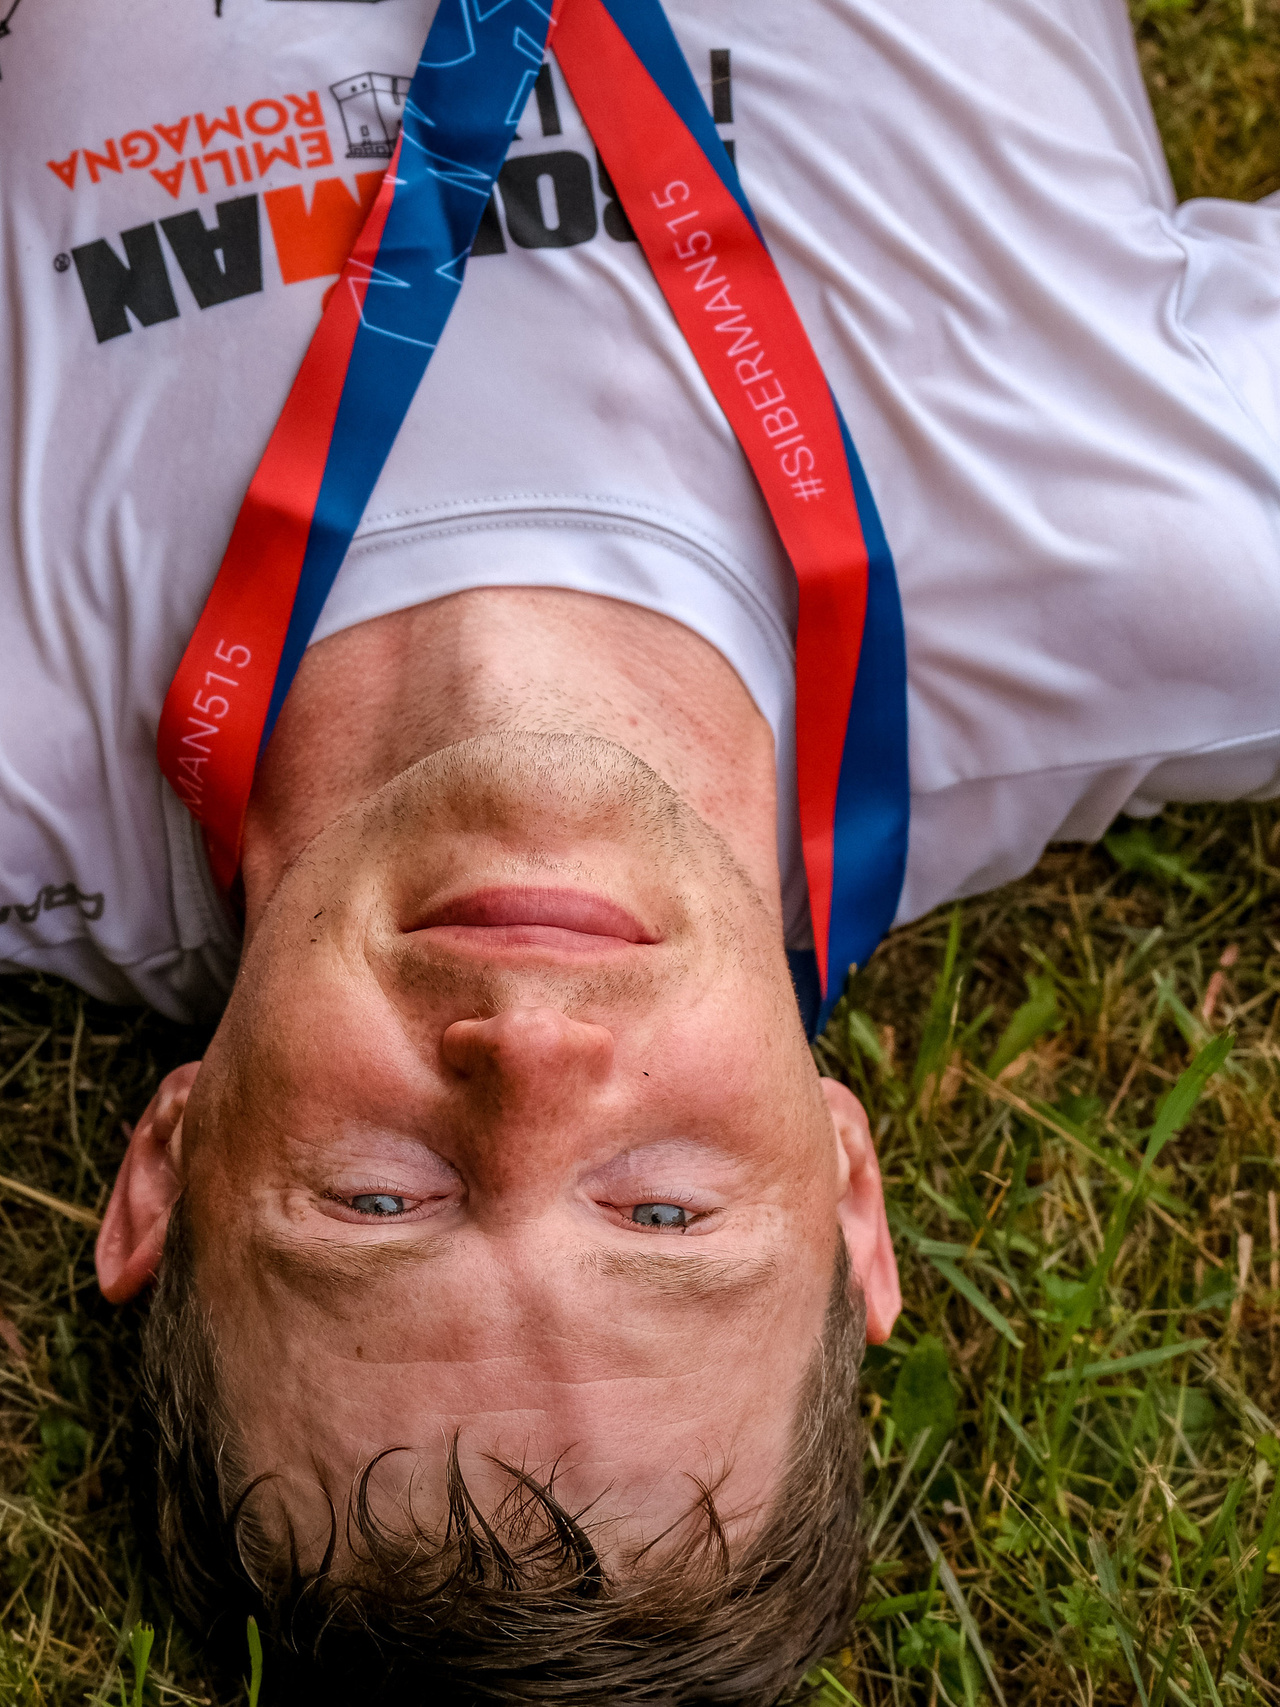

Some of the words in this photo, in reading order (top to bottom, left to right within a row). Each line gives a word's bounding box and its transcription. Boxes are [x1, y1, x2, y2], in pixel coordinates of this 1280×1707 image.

[46, 90, 325, 190] ROMAGNA
[149, 129, 335, 199] EMILIA
[650, 179, 825, 502] #SIBERMAN515
[176, 638, 252, 817] MAN515
